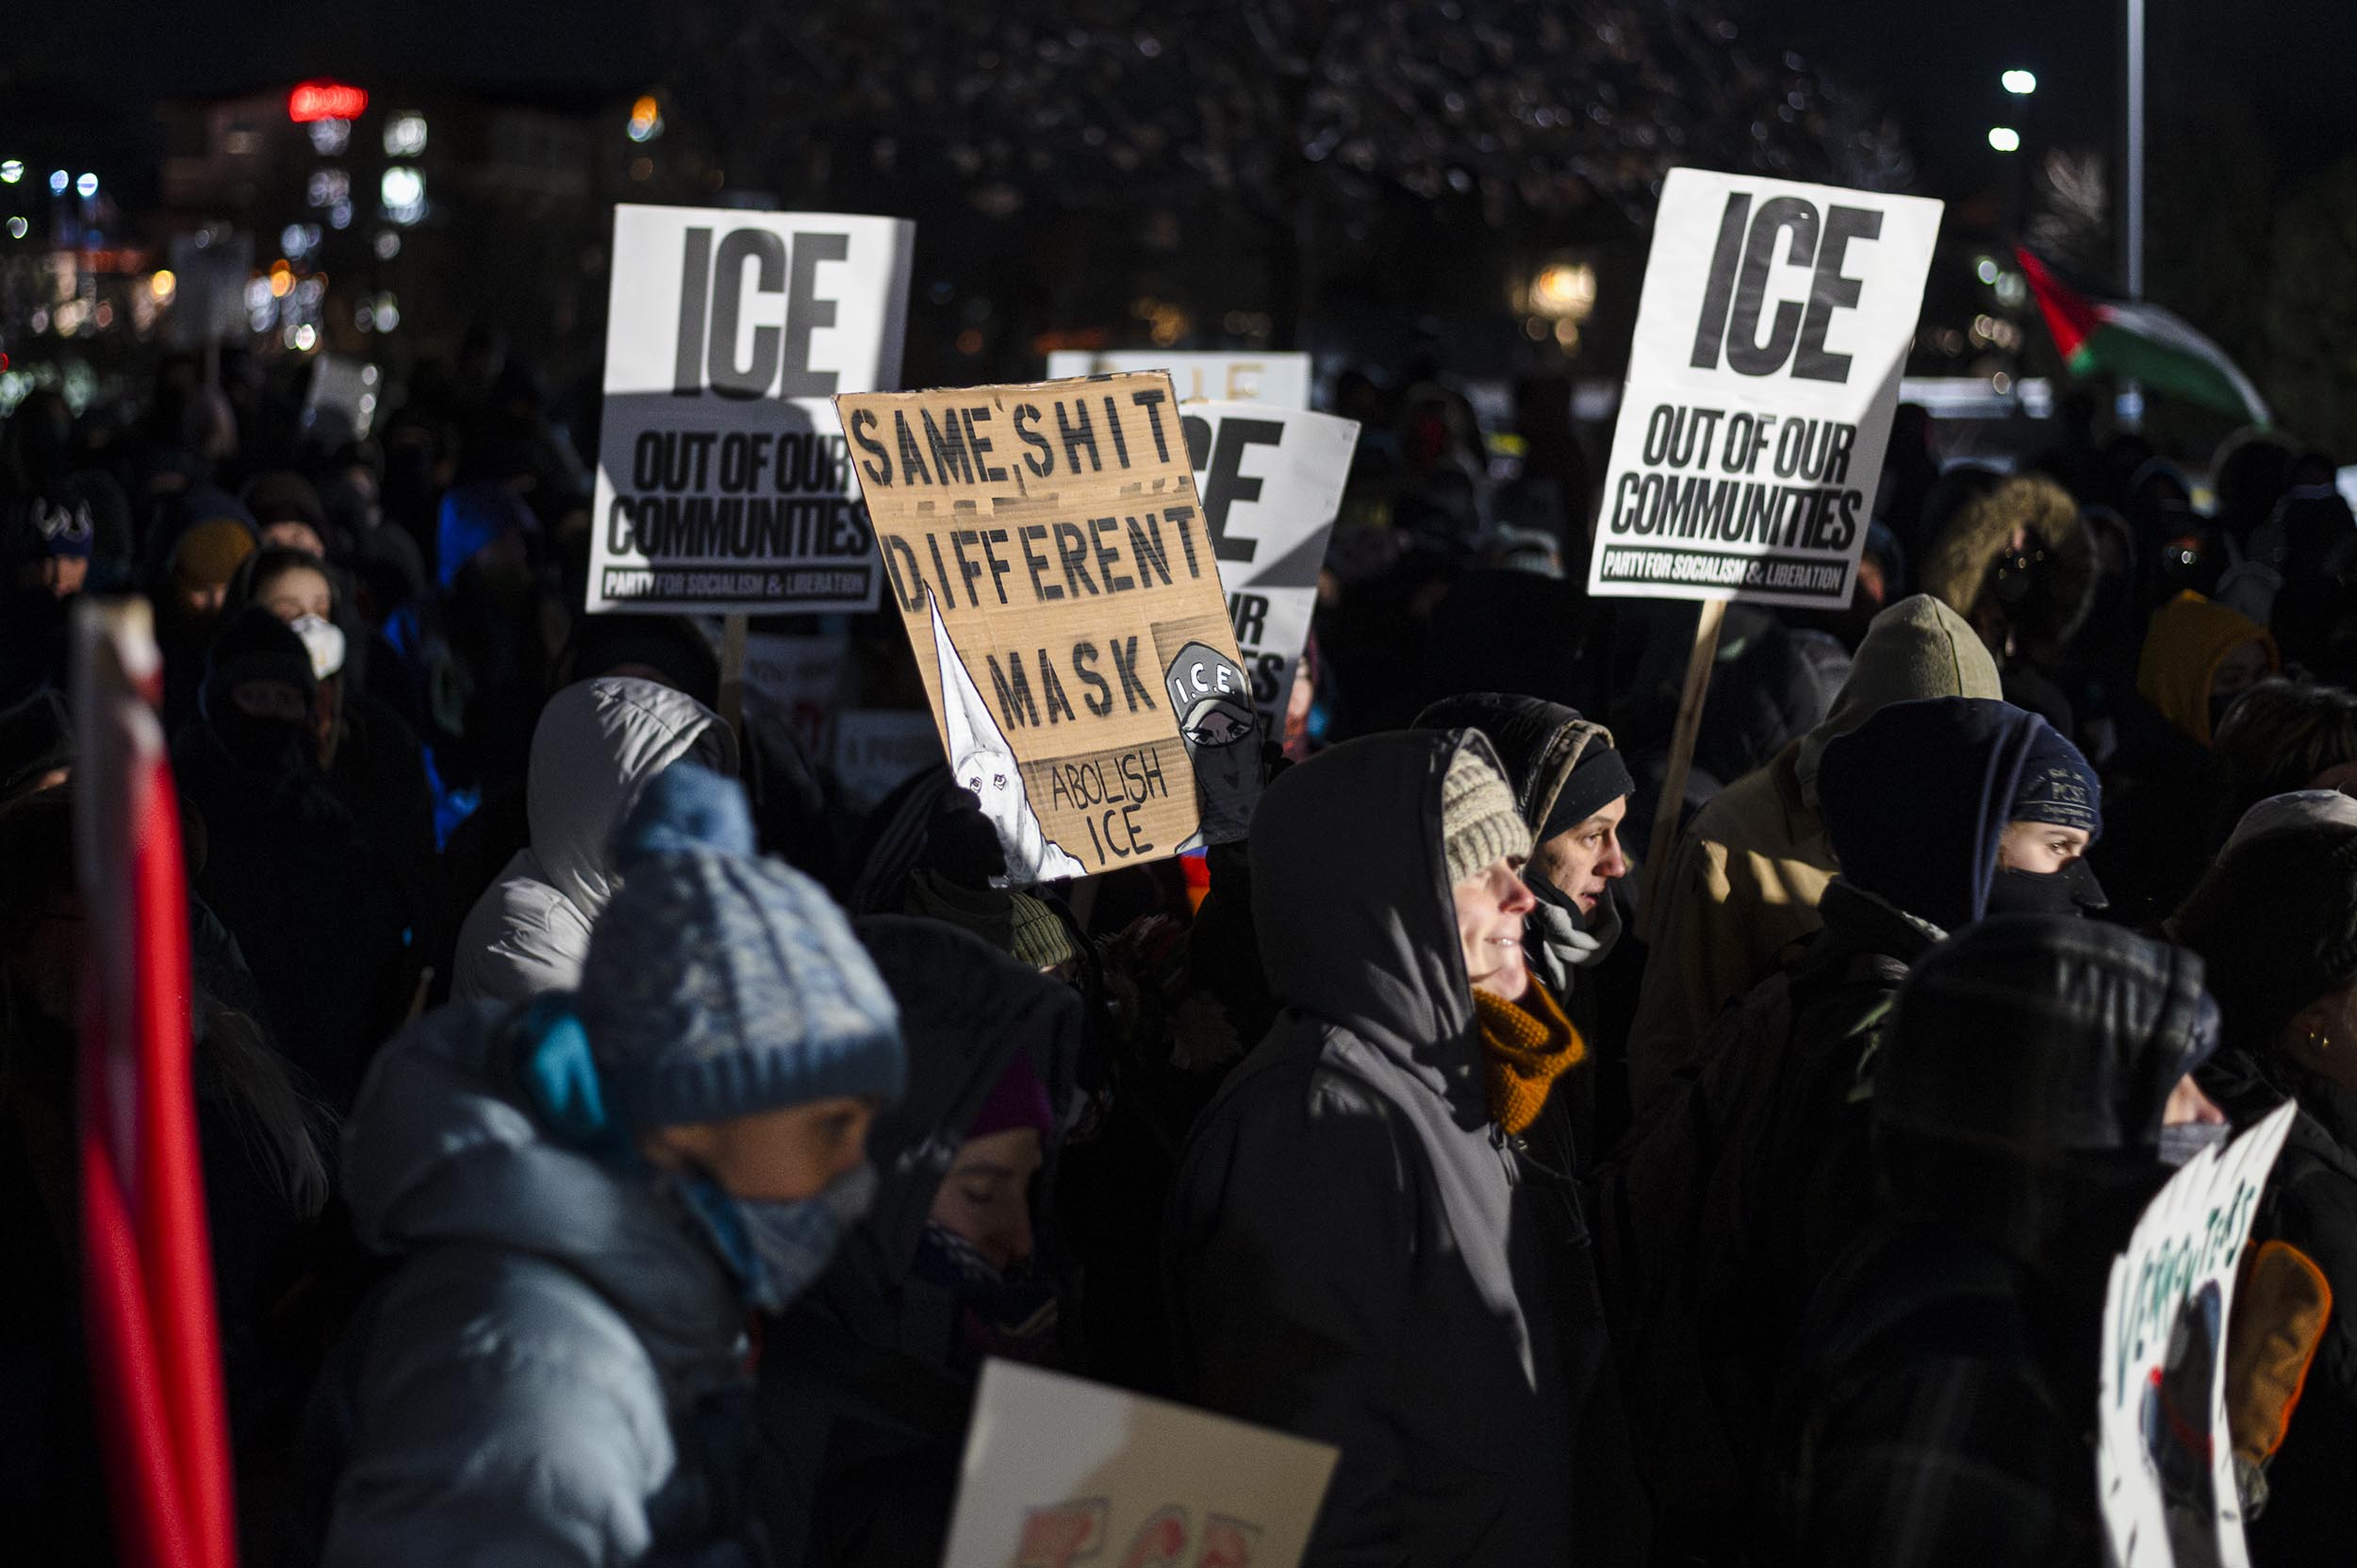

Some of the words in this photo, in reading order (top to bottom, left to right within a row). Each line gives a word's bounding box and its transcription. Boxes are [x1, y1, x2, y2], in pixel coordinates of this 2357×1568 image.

[673, 226, 850, 401] ICE
[1689, 190, 1884, 384] ICE
[634, 430, 716, 494] OUT
[719, 432, 772, 494] OF
[774, 433, 850, 496] OUR
[1014, 388, 1171, 478] SHIT
[1642, 404, 1725, 470] OUT
[1721, 411, 1777, 475] OF
[1772, 417, 1857, 486] OUR
[607, 496, 871, 557] COMMUNITIES
[1609, 470, 1862, 551] COMMUNITIES
[604, 570, 654, 597] PARTY
[657, 571, 685, 596] FOR
[686, 571, 764, 595] SOCIALISM
[766, 572, 785, 594] &
[786, 571, 864, 595] LIBERATION
[880, 504, 1201, 612] DIFFERENT
[1603, 551, 1645, 579] PARTY
[1642, 553, 1675, 580] FOR
[1672, 553, 1748, 585] SOCIALISM
[1745, 561, 1765, 583] &
[1766, 563, 1844, 589] LIBERATION
[985, 635, 1158, 731] MASK
[1051, 747, 1168, 811] ABOLISH
[1085, 803, 1154, 866] ICE
